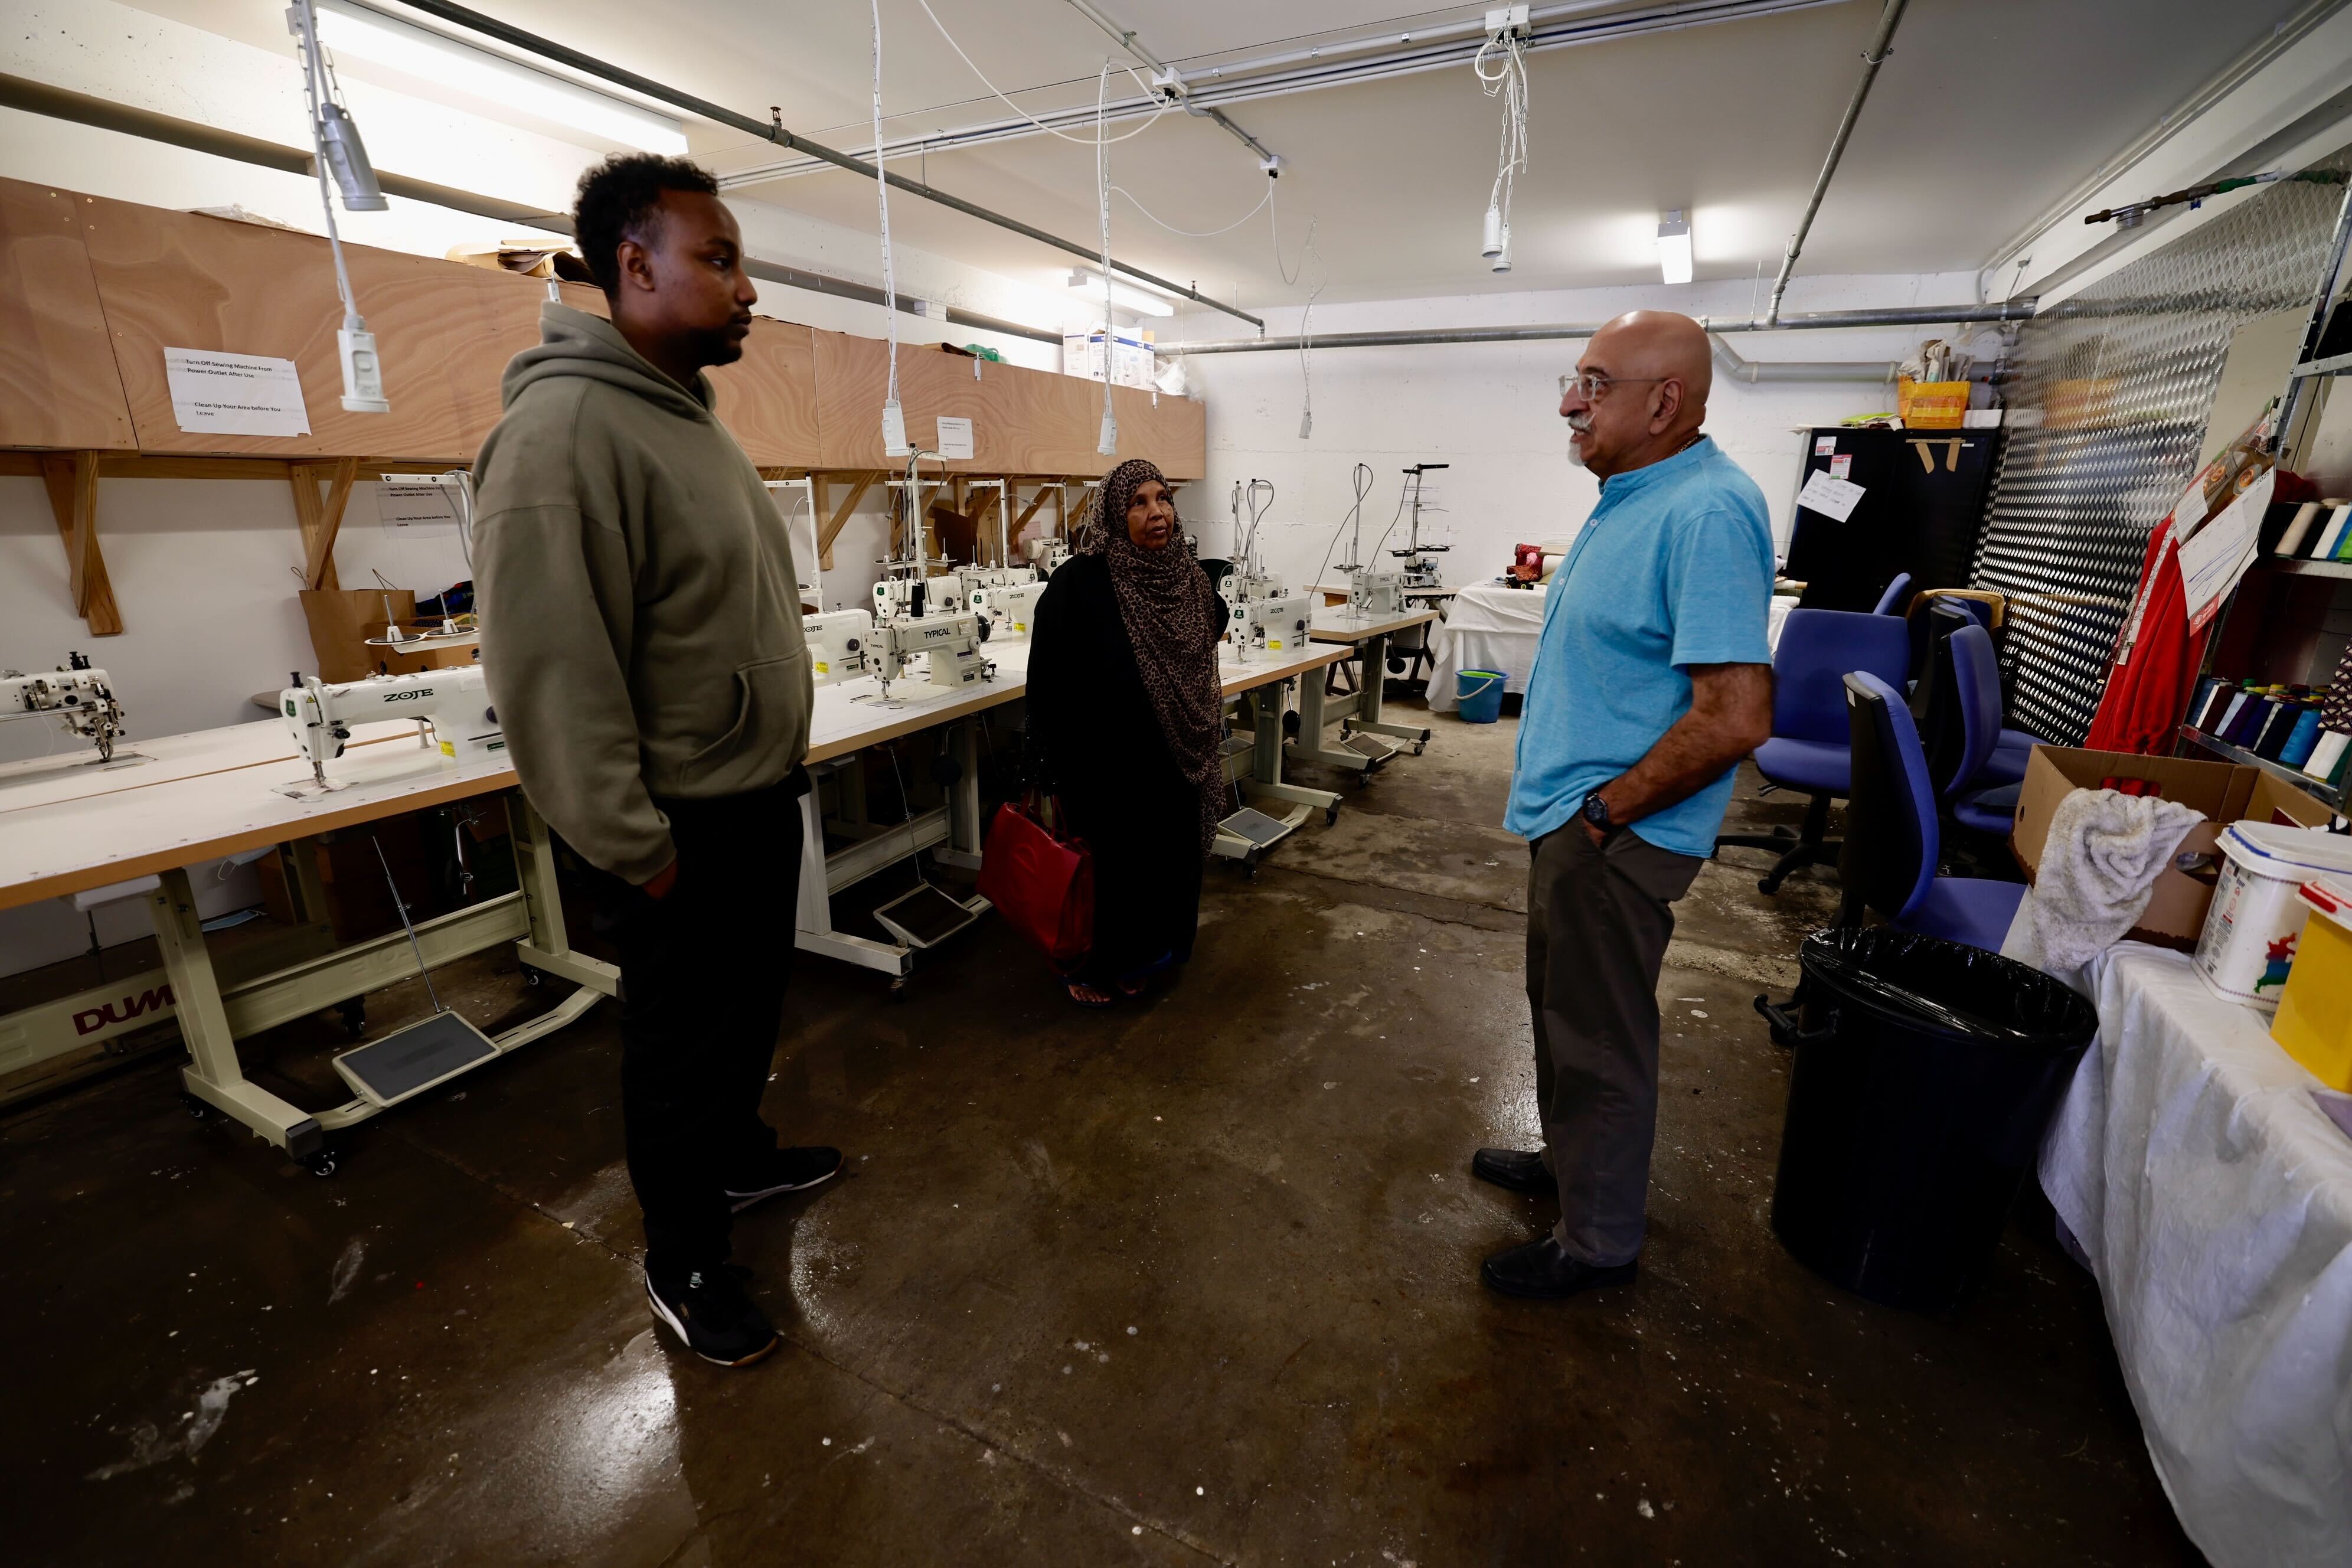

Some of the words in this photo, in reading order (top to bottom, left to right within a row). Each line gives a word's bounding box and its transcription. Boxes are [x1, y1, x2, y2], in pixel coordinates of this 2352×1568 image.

[2257, 472, 2270, 485] 2025
[924, 628, 950, 639] TYPICAL
[384, 689, 433, 702] ZOJE
